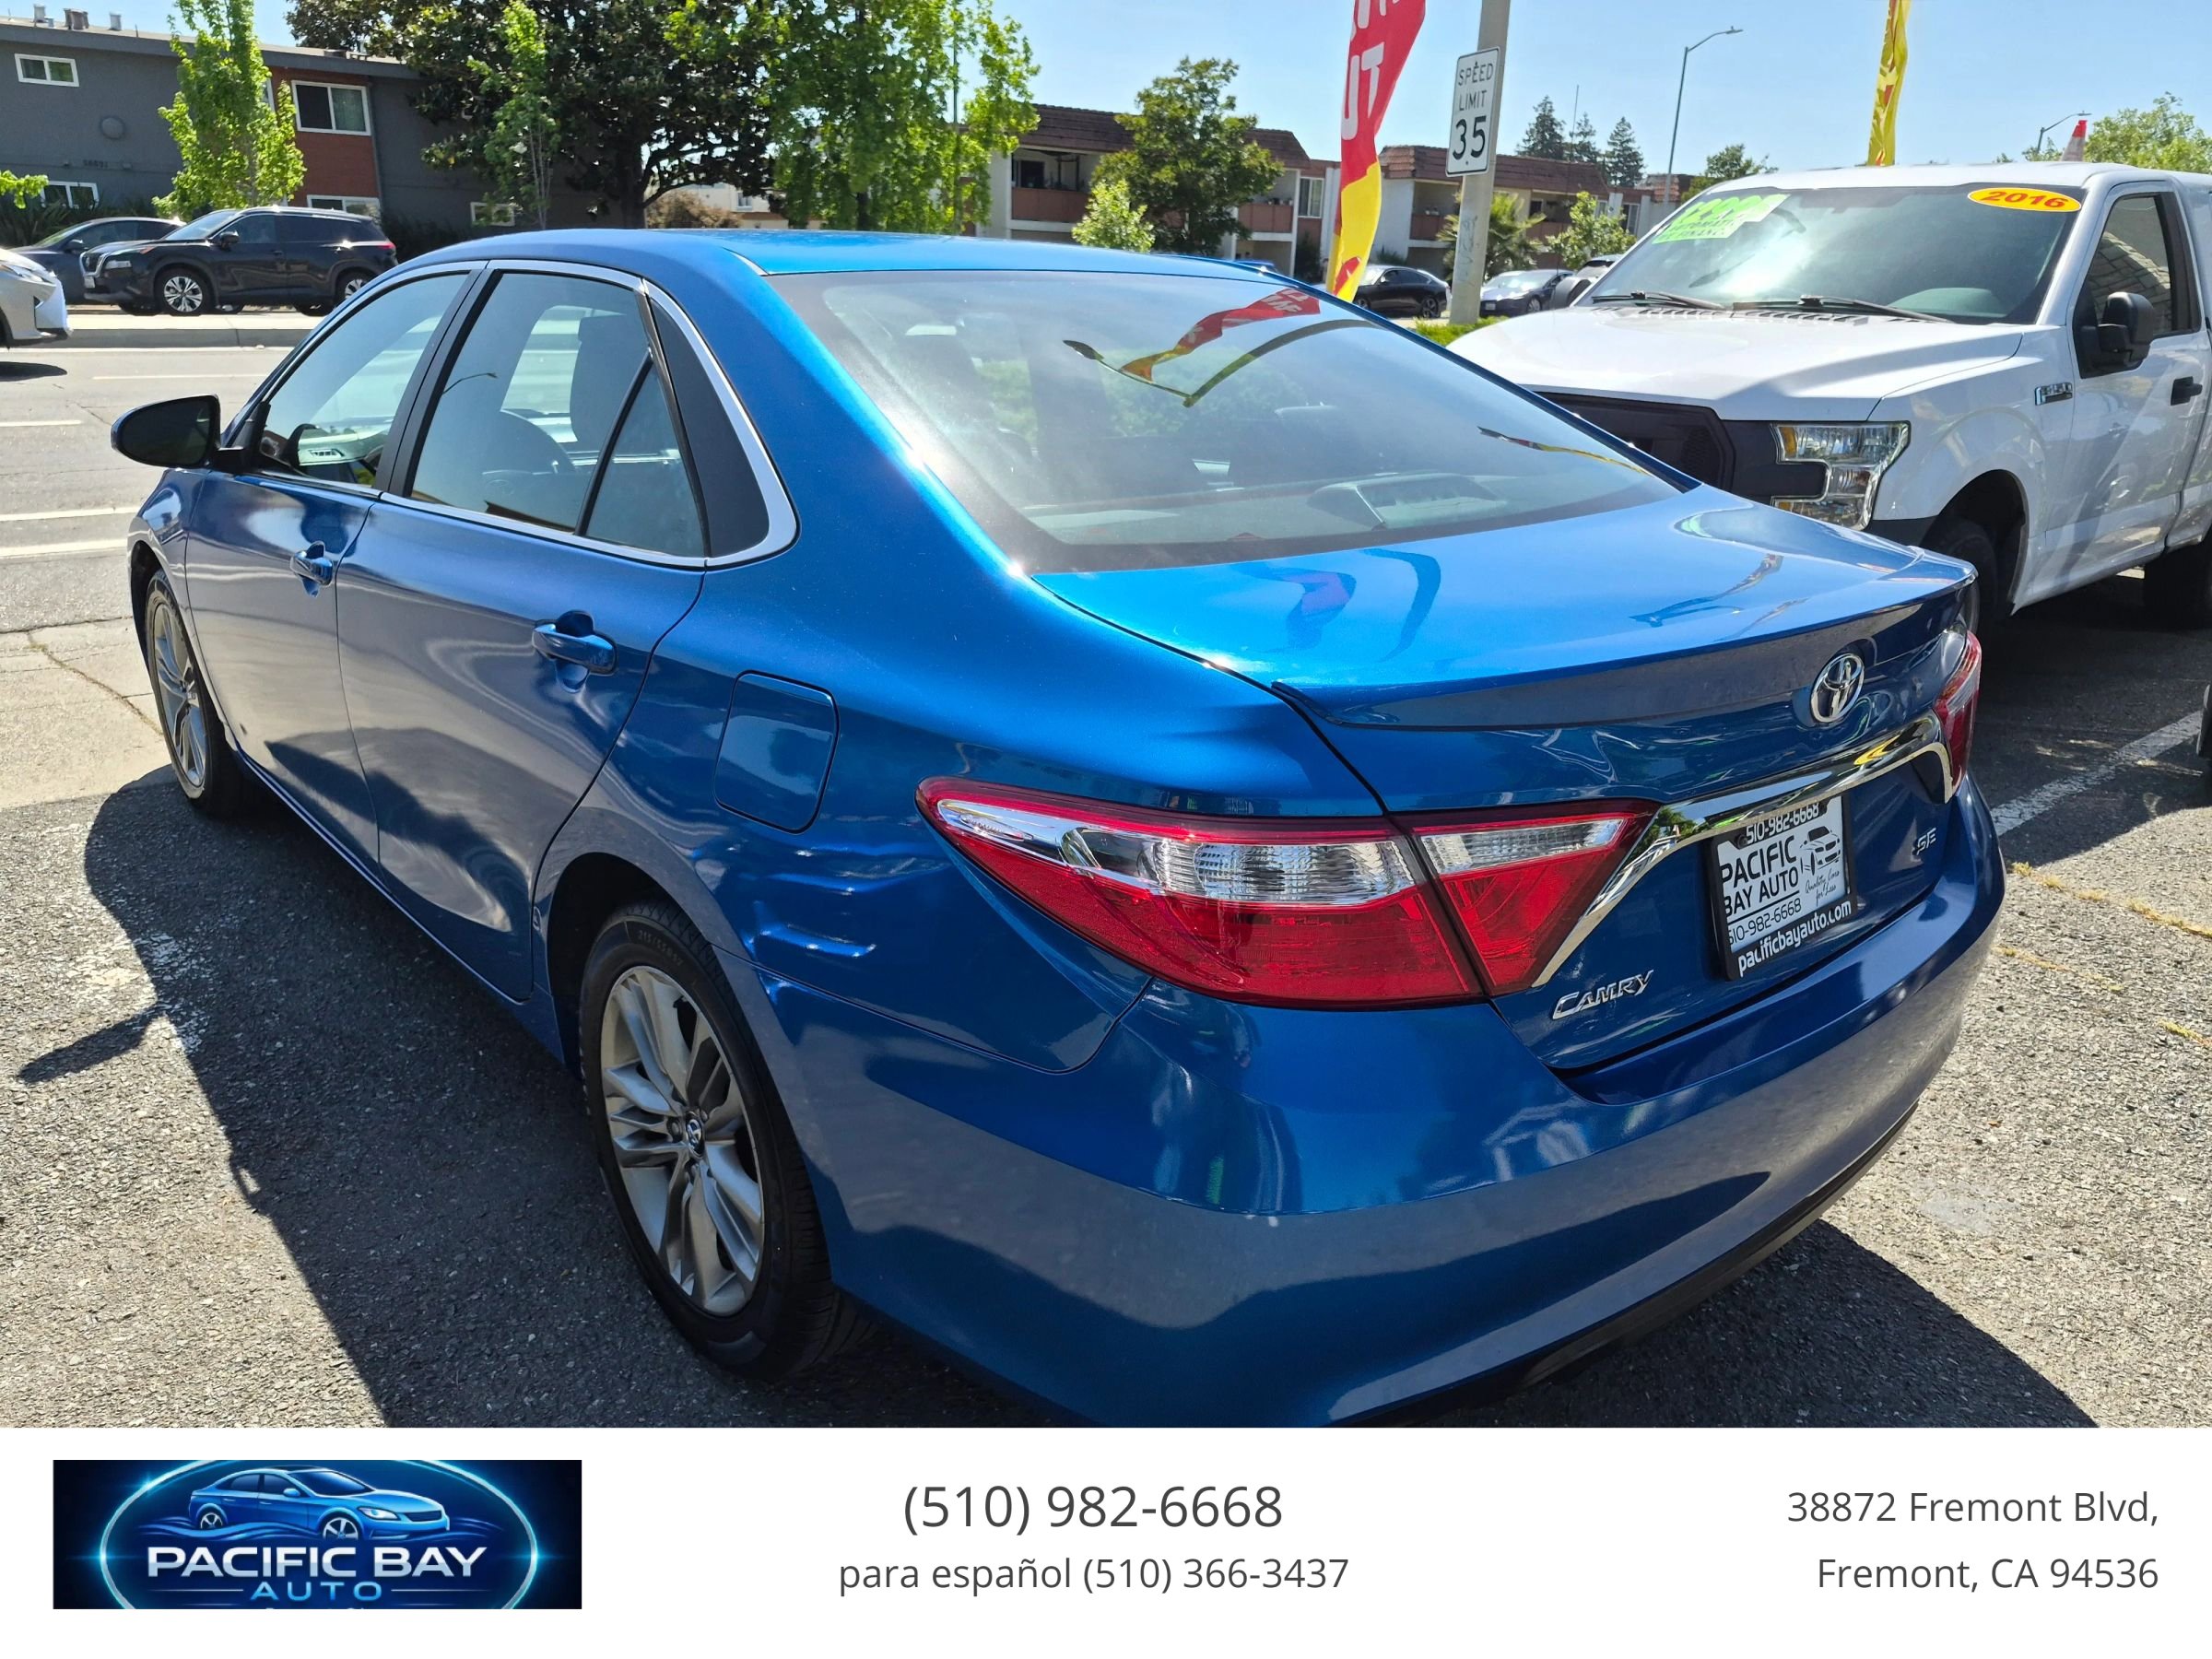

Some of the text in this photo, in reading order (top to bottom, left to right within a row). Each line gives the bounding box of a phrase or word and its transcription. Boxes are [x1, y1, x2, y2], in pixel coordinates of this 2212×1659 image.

[1458, 63, 1493, 86] SPEED
[1459, 90, 1487, 112] LIMIT
[1453, 115, 1487, 159] 35
[1980, 191, 2068, 208] 2016
[1720, 835, 1797, 888] PACIFIC
[1916, 828, 1936, 855] SE
[1724, 866, 1799, 917] BAY AUTO
[1738, 900, 1852, 977] pacificbayauto.com
[1552, 969, 1654, 1020] CAMRY
